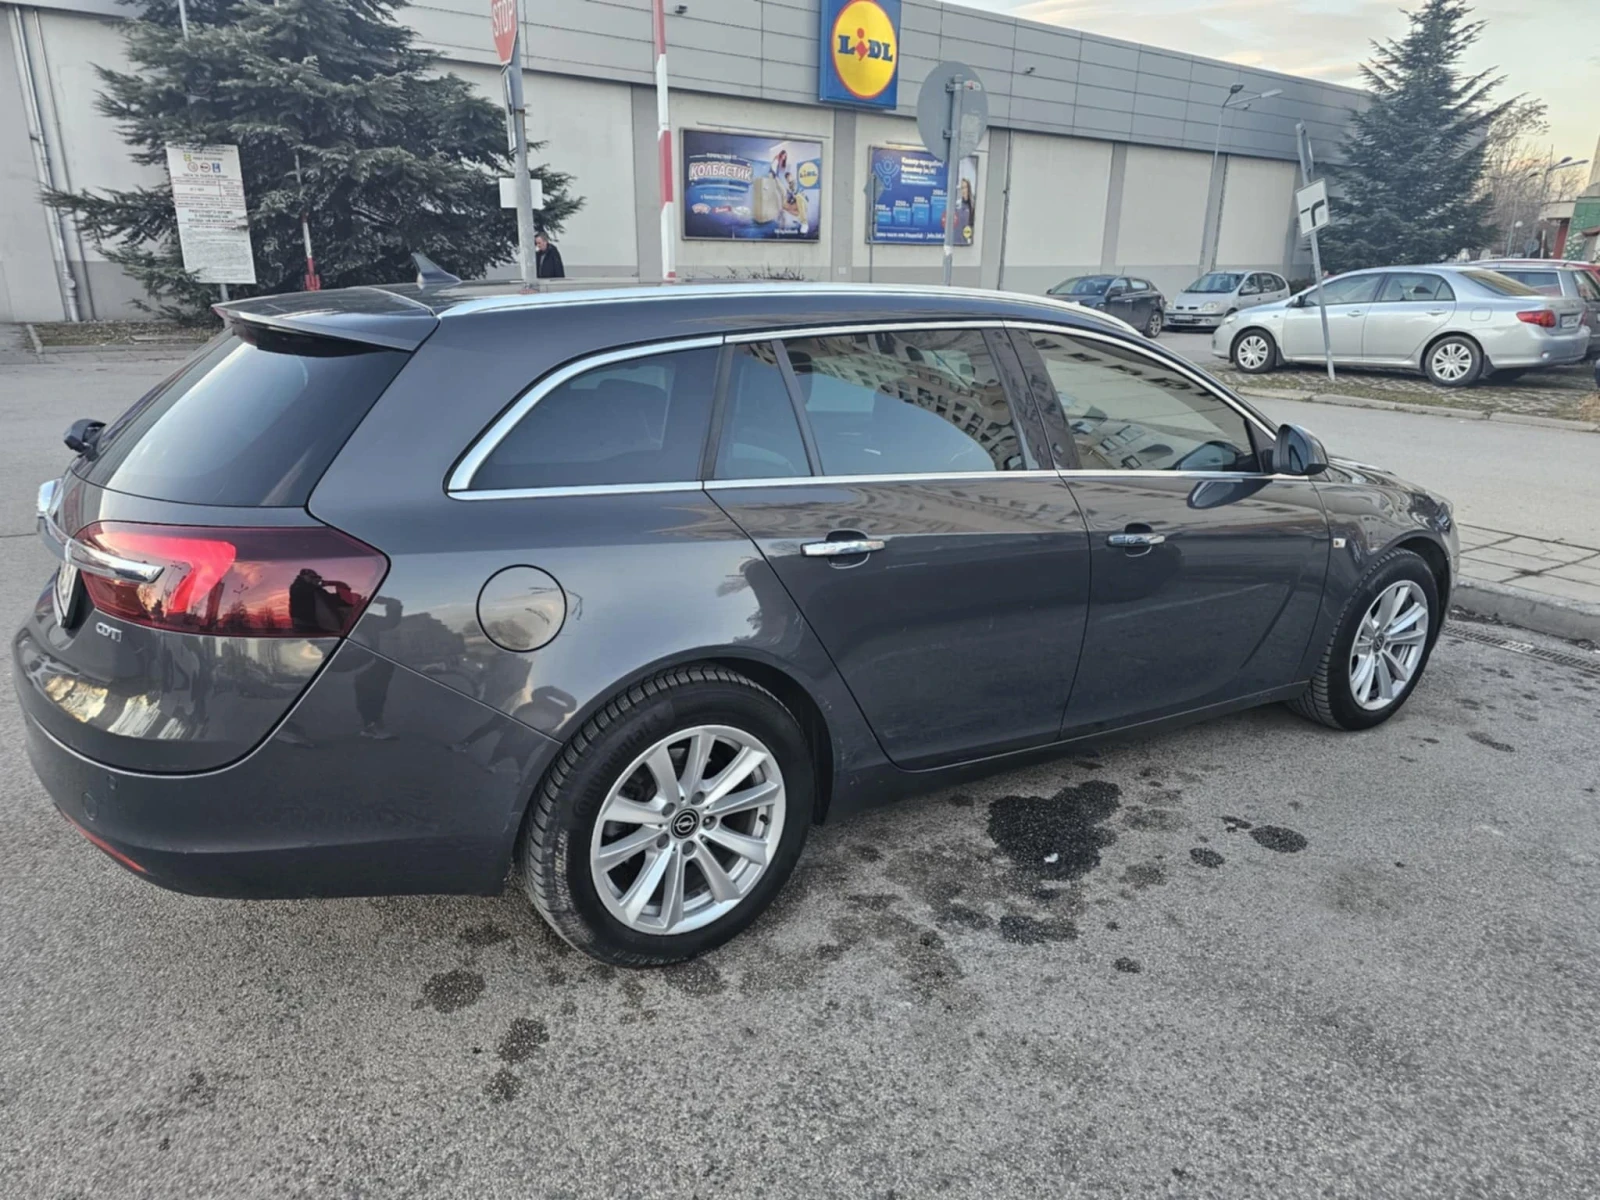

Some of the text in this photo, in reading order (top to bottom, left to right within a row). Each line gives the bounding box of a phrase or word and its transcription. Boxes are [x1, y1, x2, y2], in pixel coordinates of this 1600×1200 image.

[493, 0, 513, 37] STOP
[838, 28, 893, 62] LIDL
[690, 163, 752, 182] КОЛБАСТИК
